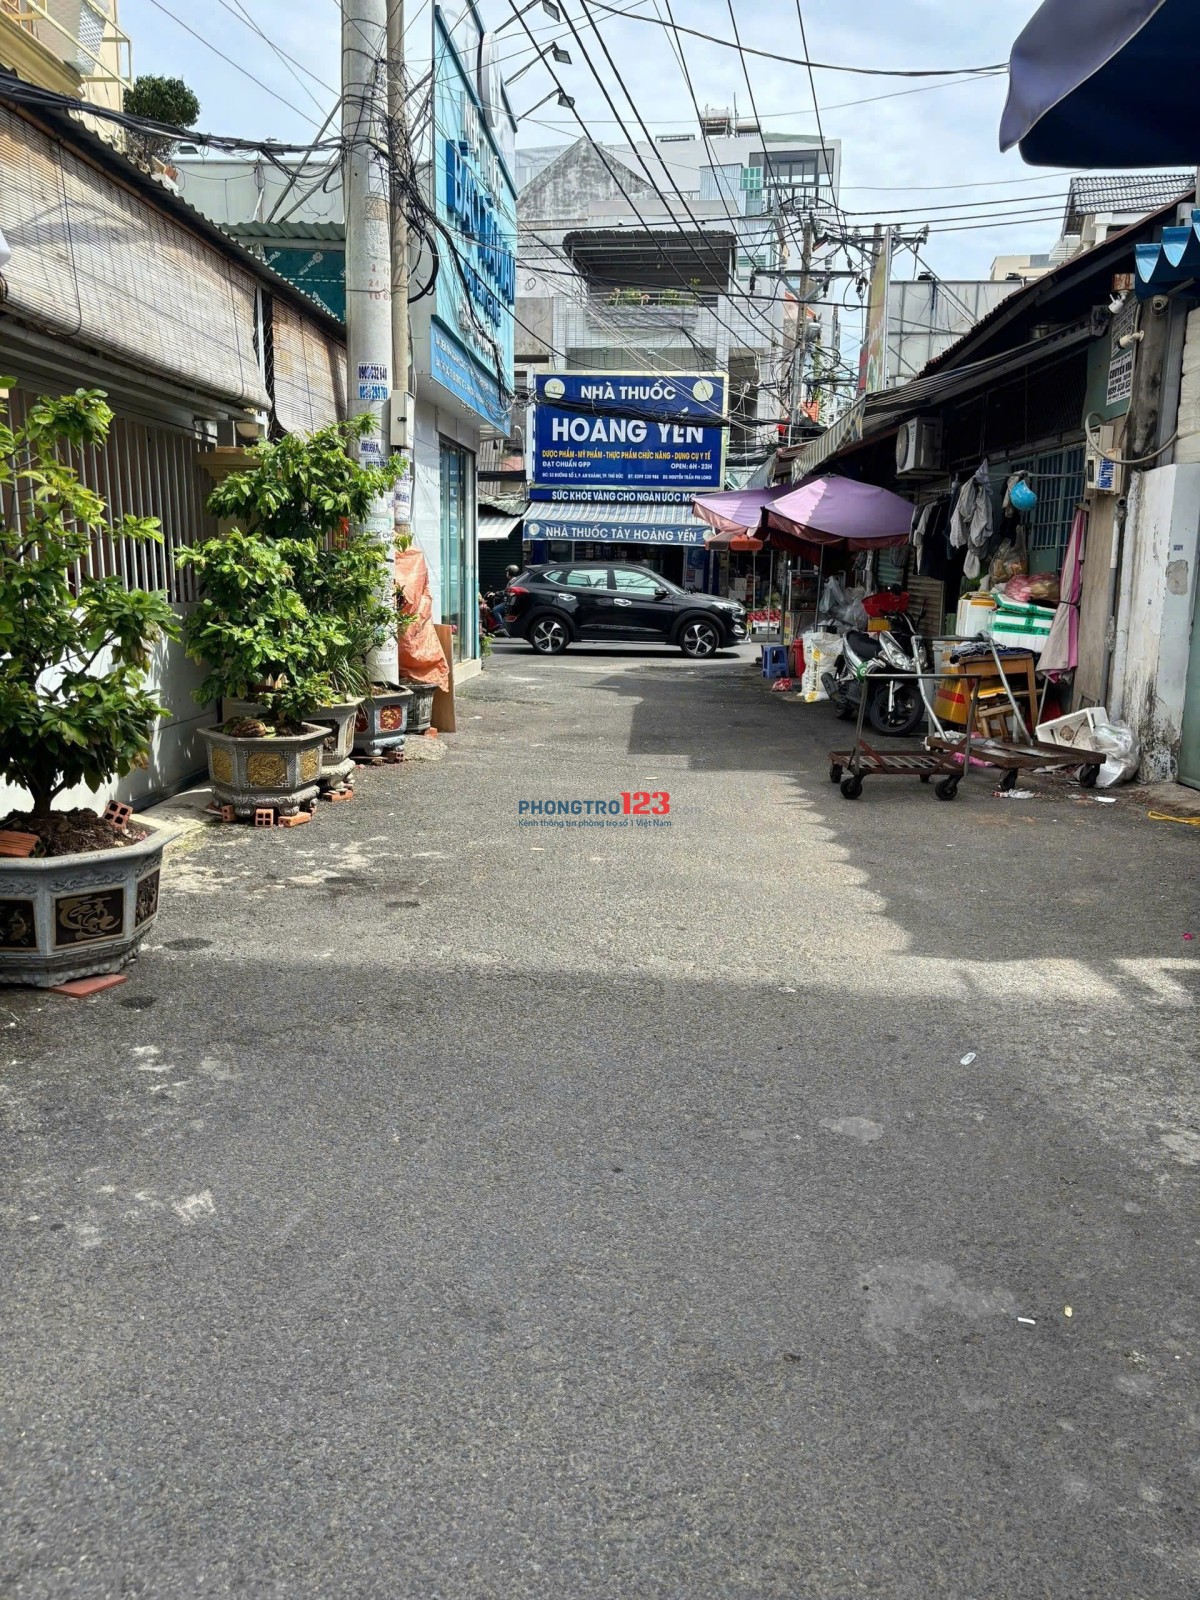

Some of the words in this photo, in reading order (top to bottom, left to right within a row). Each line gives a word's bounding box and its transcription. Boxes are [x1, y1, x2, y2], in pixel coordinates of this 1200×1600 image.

[580, 381, 616, 400] NHÀ
[619, 379, 677, 400] THUỐC
[542, 449, 558, 460] DƯỢC
[559, 447, 575, 458] PHẨM
[586, 447, 603, 459] PHẨM
[606, 450, 621, 460] THỰC
[621, 448, 638, 459] PHẨM
[638, 449, 654, 460] CHỨC
[654, 450, 671, 460] NĂNG
[674, 452, 690, 461] DỤNG
[690, 452, 699, 462] CỤ
[699, 452, 704, 460] Y
[704, 450, 712, 460] TẾ
[555, 458, 577, 468] CHUẨN
[552, 489, 569, 501] SỨC
[570, 490, 592, 501] KHỎE
[593, 490, 616, 501] VÀNG
[616, 491, 636, 502] CHO
[637, 491, 661, 502] NGÀN
[662, 491, 681, 502] ƯỚC
[545, 524, 569, 538] NHÀ
[571, 524, 609, 539] THUỐC
[611, 526, 631, 540] TÂY
[633, 528, 674, 541] HOÀNG
[677, 527, 697, 542] YẾN
